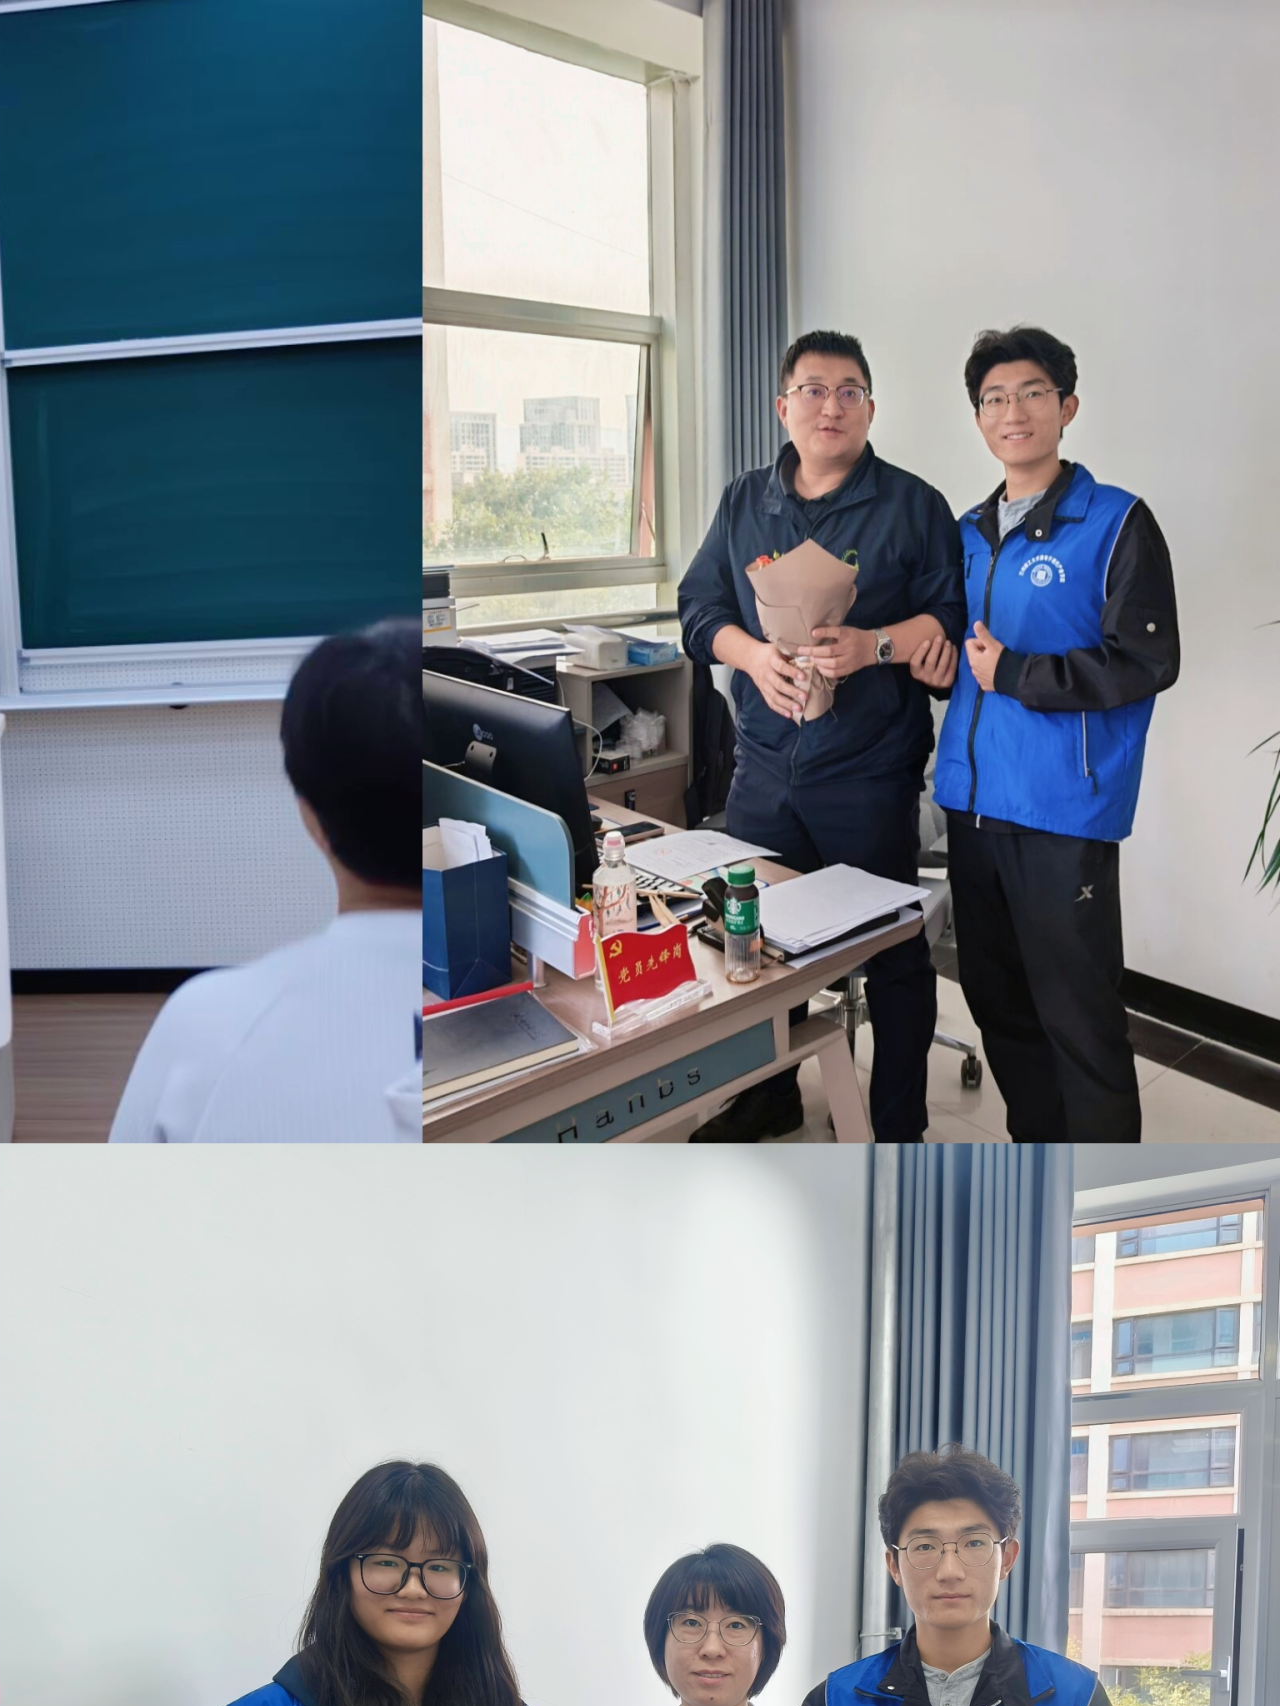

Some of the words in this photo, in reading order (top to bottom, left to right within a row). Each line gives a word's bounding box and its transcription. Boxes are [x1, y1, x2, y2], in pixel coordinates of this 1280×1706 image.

[618, 942, 682, 985] 党员先锋岗
